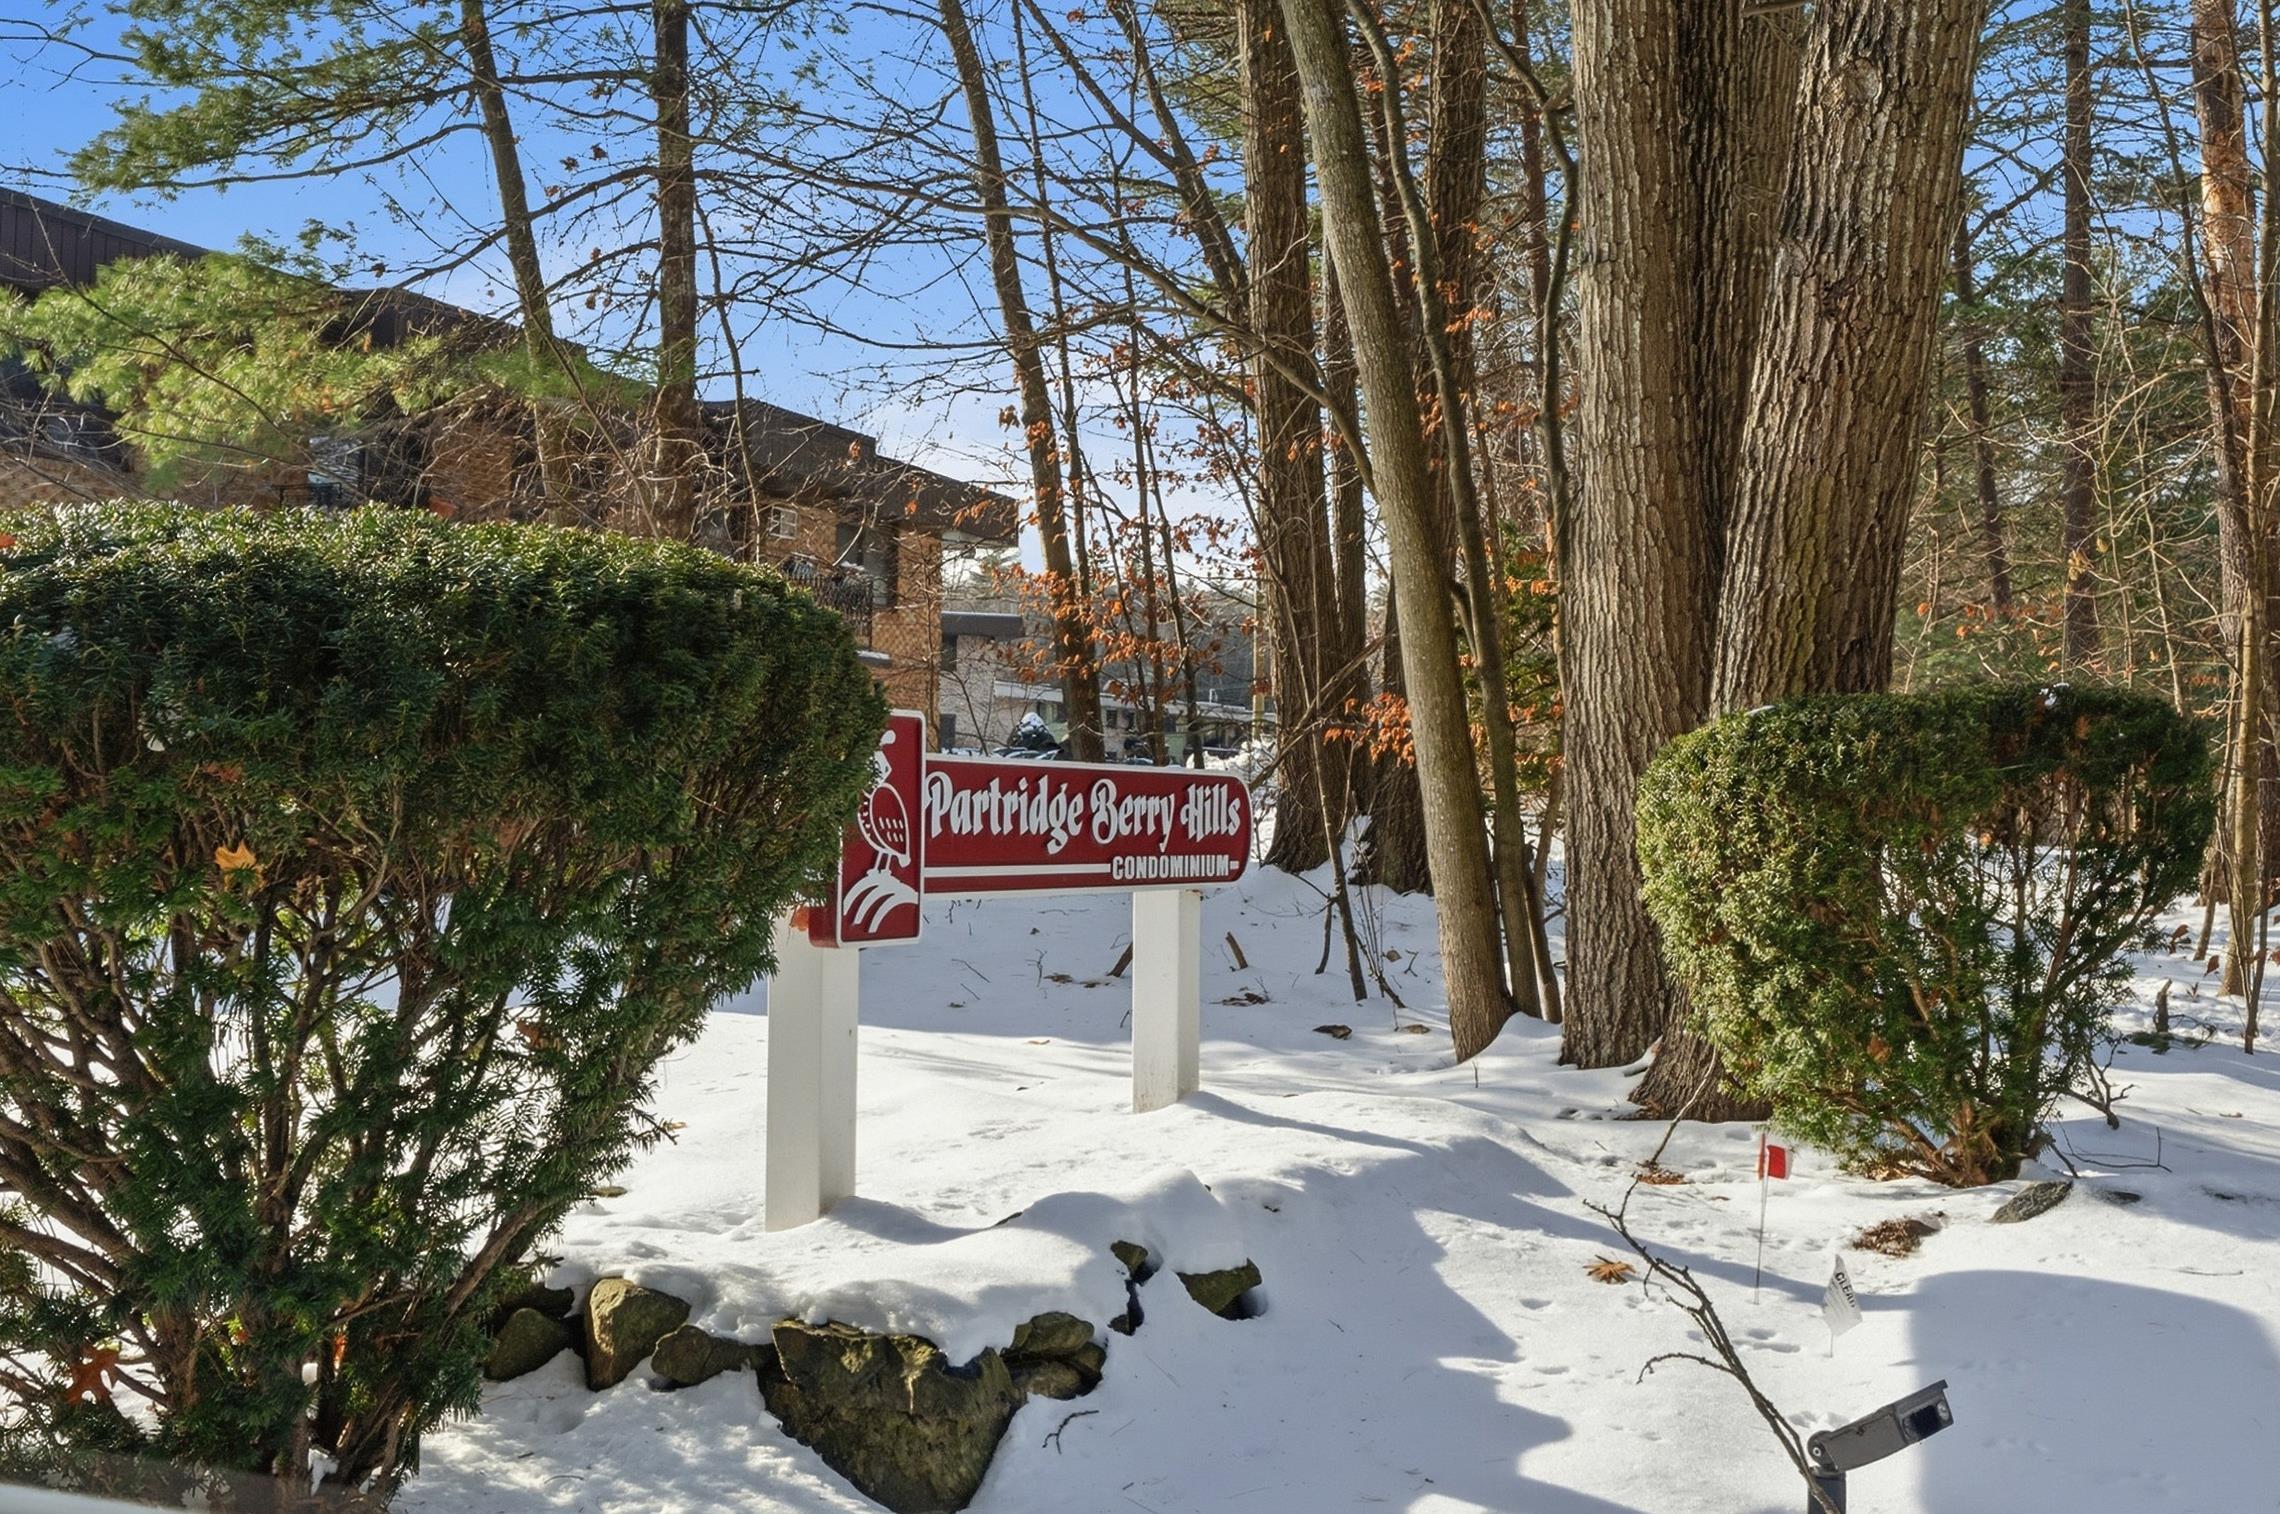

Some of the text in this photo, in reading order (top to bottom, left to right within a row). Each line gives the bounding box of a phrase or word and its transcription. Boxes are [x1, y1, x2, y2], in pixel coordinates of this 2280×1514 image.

[924, 771, 1241, 855] Partridge Berry Hills
[1112, 854, 1229, 880] CONDOMINIUM
